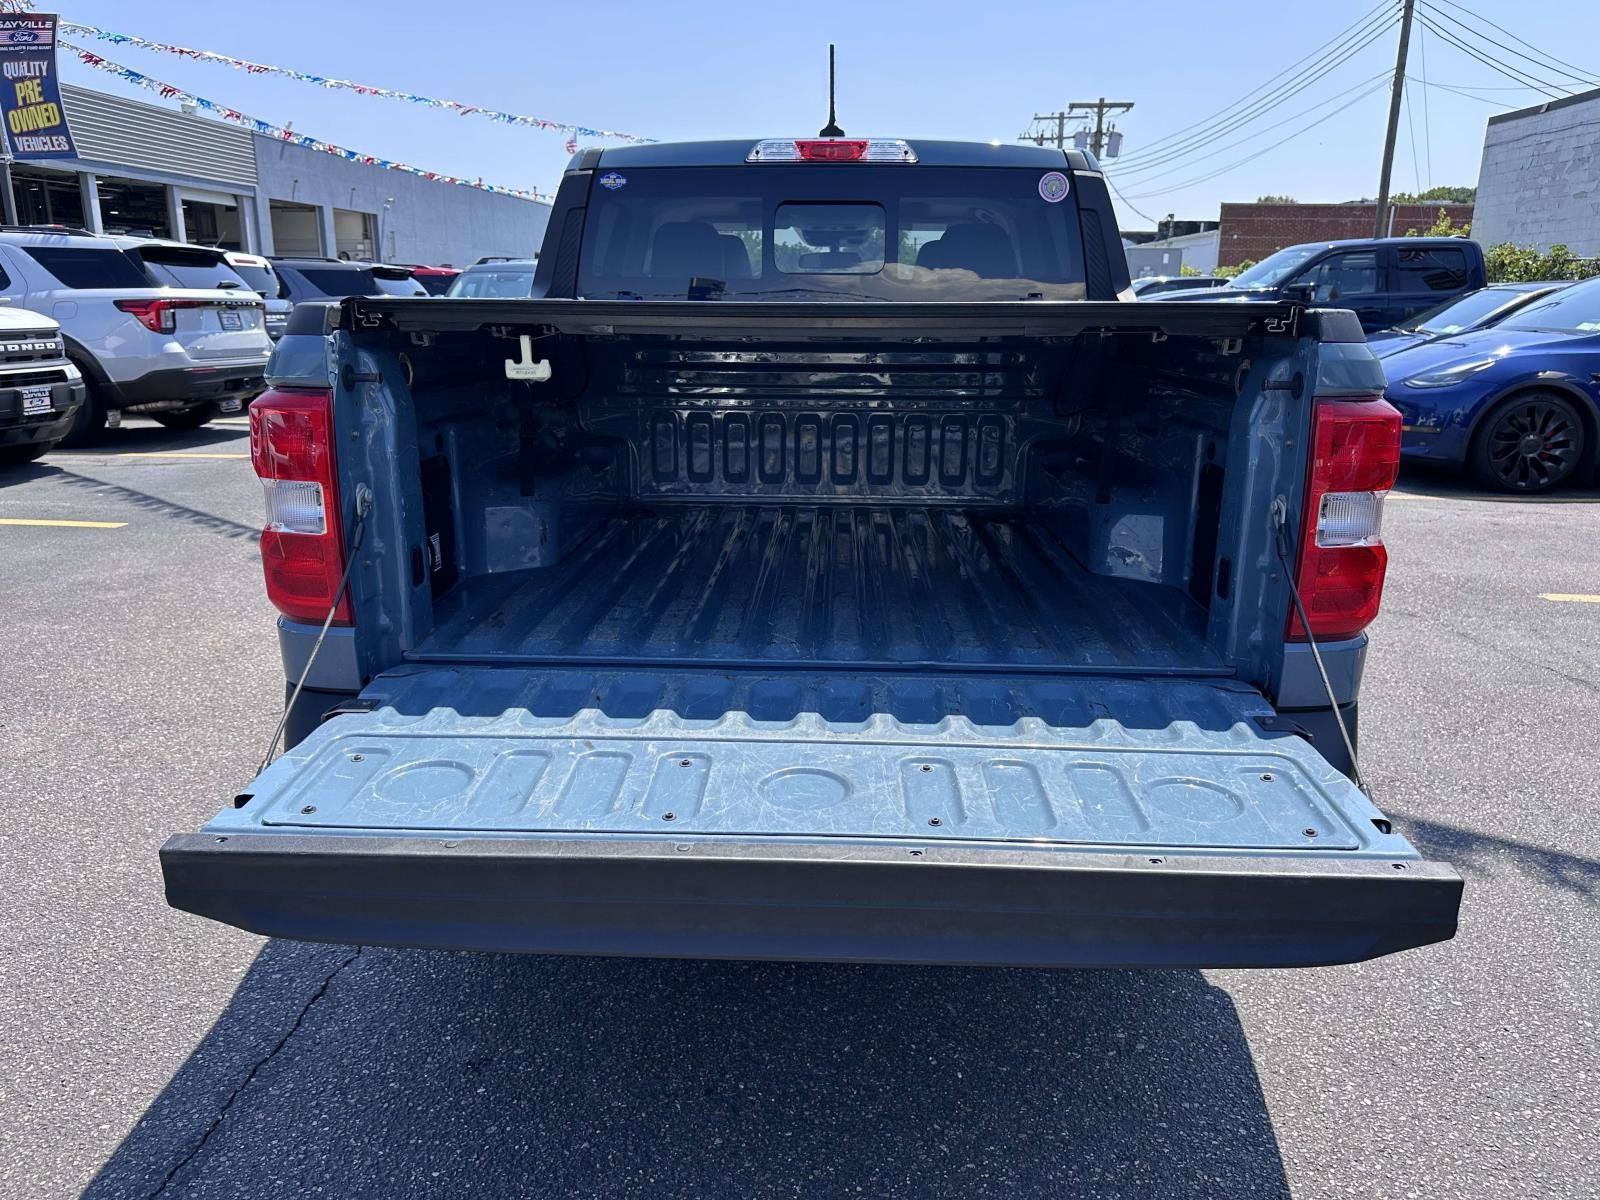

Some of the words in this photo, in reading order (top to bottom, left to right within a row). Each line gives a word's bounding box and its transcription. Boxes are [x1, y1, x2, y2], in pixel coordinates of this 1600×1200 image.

[13, 31, 34, 42] Ford
[3, 61, 48, 79] QUALITY
[15, 79, 44, 106] PRE
[8, 102, 61, 134] OWNED
[14, 136, 70, 152] VEHICLES
